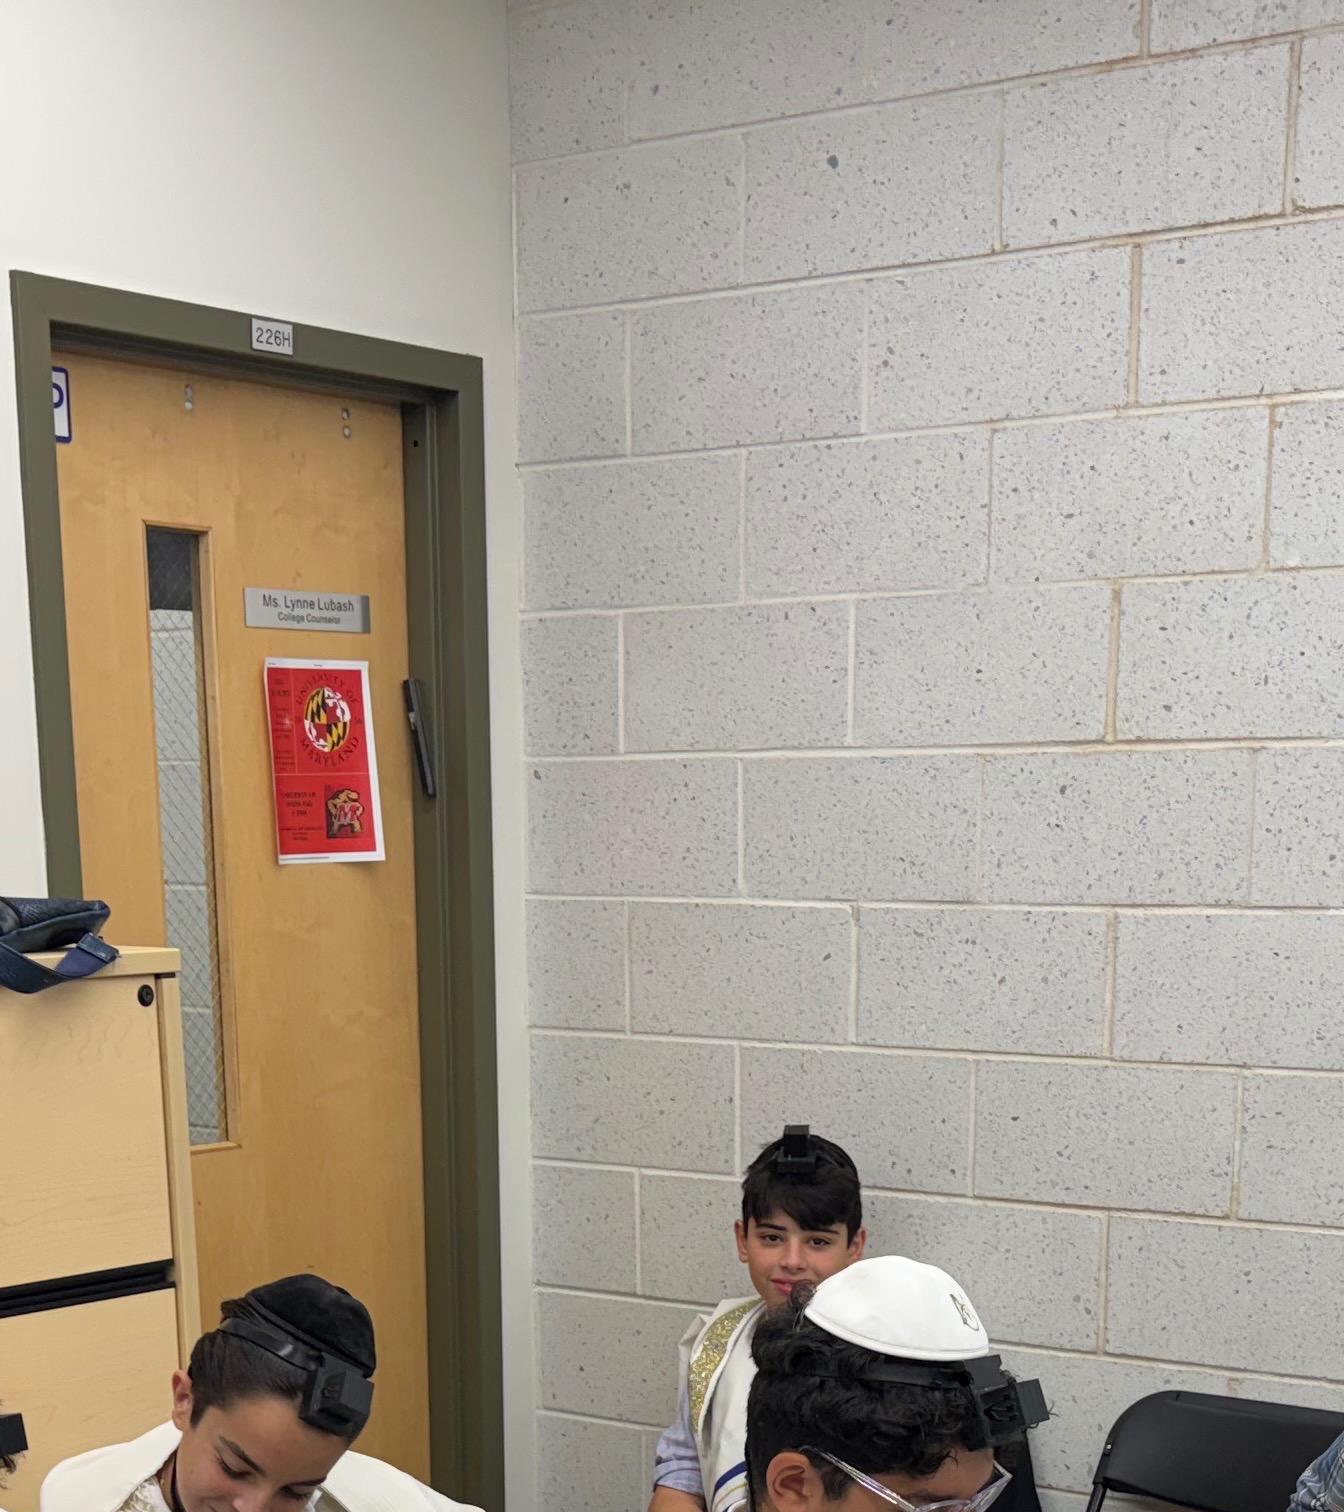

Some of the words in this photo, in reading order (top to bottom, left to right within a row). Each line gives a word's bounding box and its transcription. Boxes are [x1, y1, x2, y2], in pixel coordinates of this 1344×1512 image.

[256, 327, 291, 347] 226H
[262, 594, 281, 608] Ms.
[284, 596, 315, 611] Lynne
[317, 598, 354, 612] Lubash
[278, 612, 304, 624] College
[306, 614, 341, 624] Counselor
